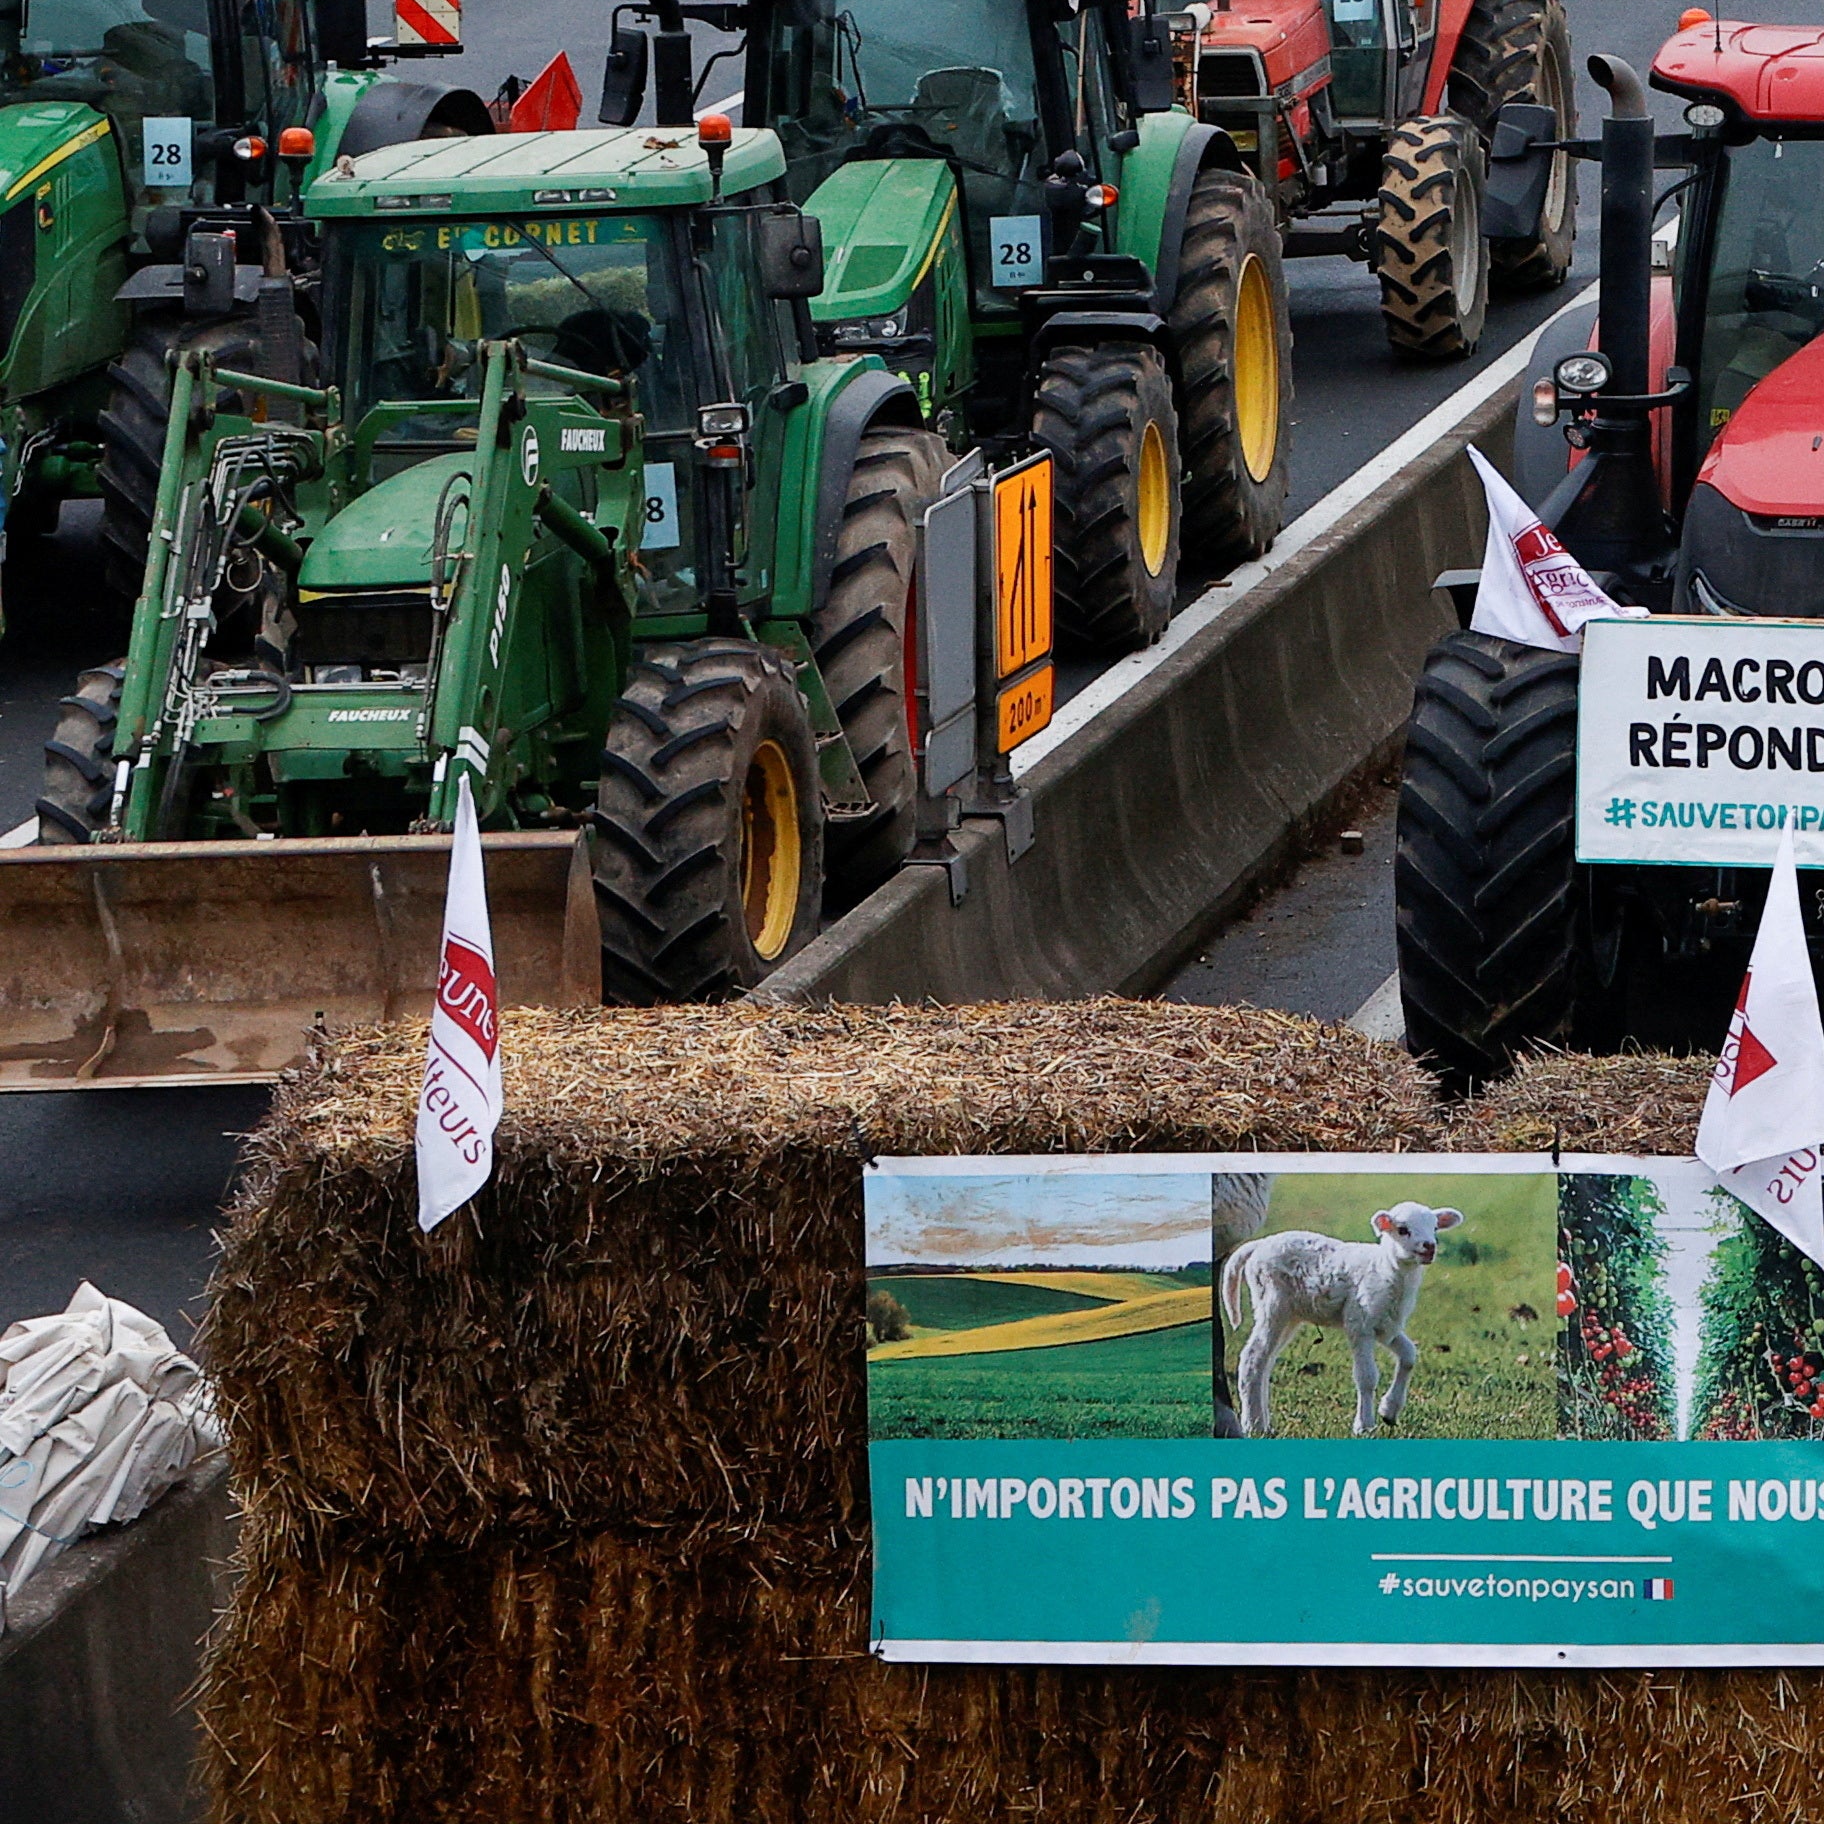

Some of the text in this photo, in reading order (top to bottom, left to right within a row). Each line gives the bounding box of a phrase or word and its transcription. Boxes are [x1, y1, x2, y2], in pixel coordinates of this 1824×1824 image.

[151, 143, 182, 166] 28
[1000, 242, 1032, 266] 28
[560, 428, 606, 453] FAUCHEUX
[645, 495, 666, 524] 8
[327, 708, 411, 723] FAUCHEUX
[1009, 690, 1033, 735] 200
[1210, 1476, 1289, 1521] PAS
[1627, 1479, 1714, 1532] QUE
[1378, 1573, 1637, 1603] #sauvetonpaysan
